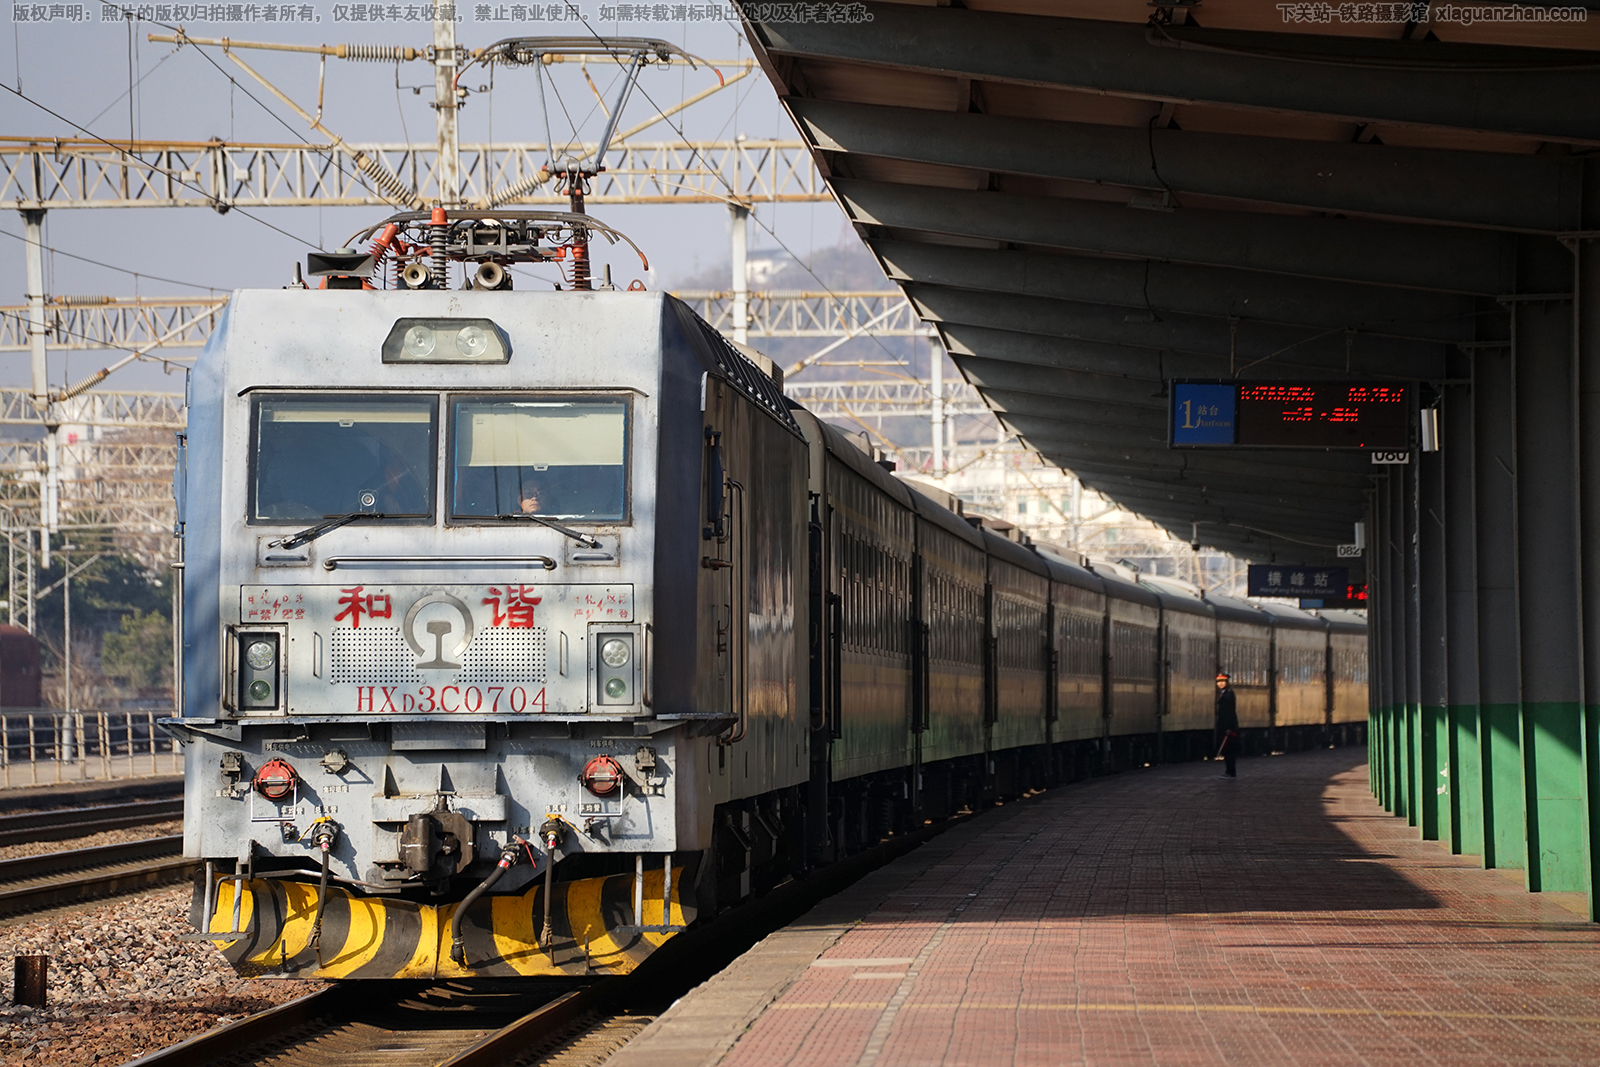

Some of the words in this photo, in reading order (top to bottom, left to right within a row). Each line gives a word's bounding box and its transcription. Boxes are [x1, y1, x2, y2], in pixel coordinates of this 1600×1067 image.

[1181, 399, 1194, 429] 1
[1197, 405, 1219, 416] 站台
[1339, 546, 1360, 556] 082
[1267, 571, 1329, 587] 横峰站
[334, 585, 392, 629] 和
[481, 584, 542, 629] 谐
[356, 685, 549, 713] HXD3C0704
